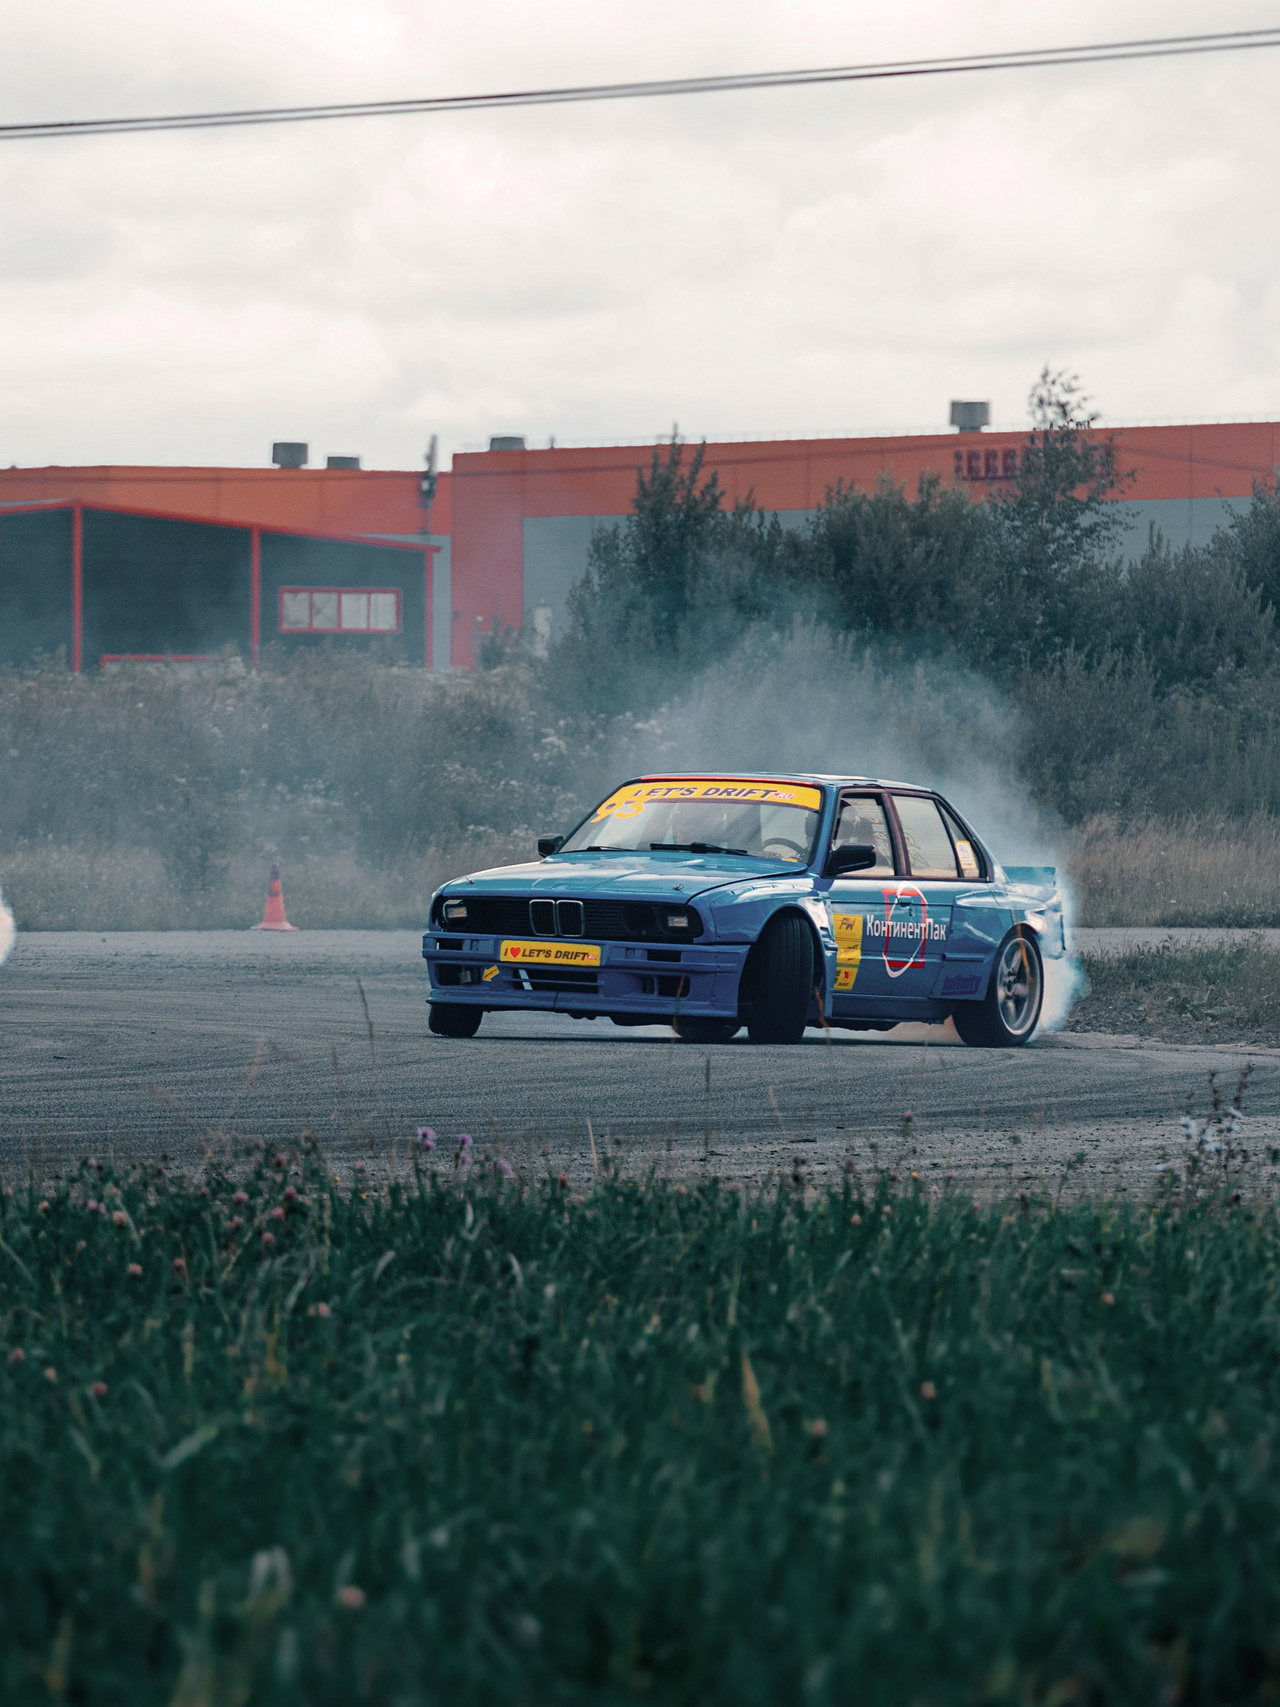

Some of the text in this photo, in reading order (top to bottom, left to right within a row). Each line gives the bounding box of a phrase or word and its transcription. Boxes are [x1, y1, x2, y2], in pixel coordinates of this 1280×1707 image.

[589, 797, 647, 824] 93
[866, 914, 947, 941] КонтинентПак
[504, 947, 509, 957] I
[521, 948, 552, 959] LET'S
